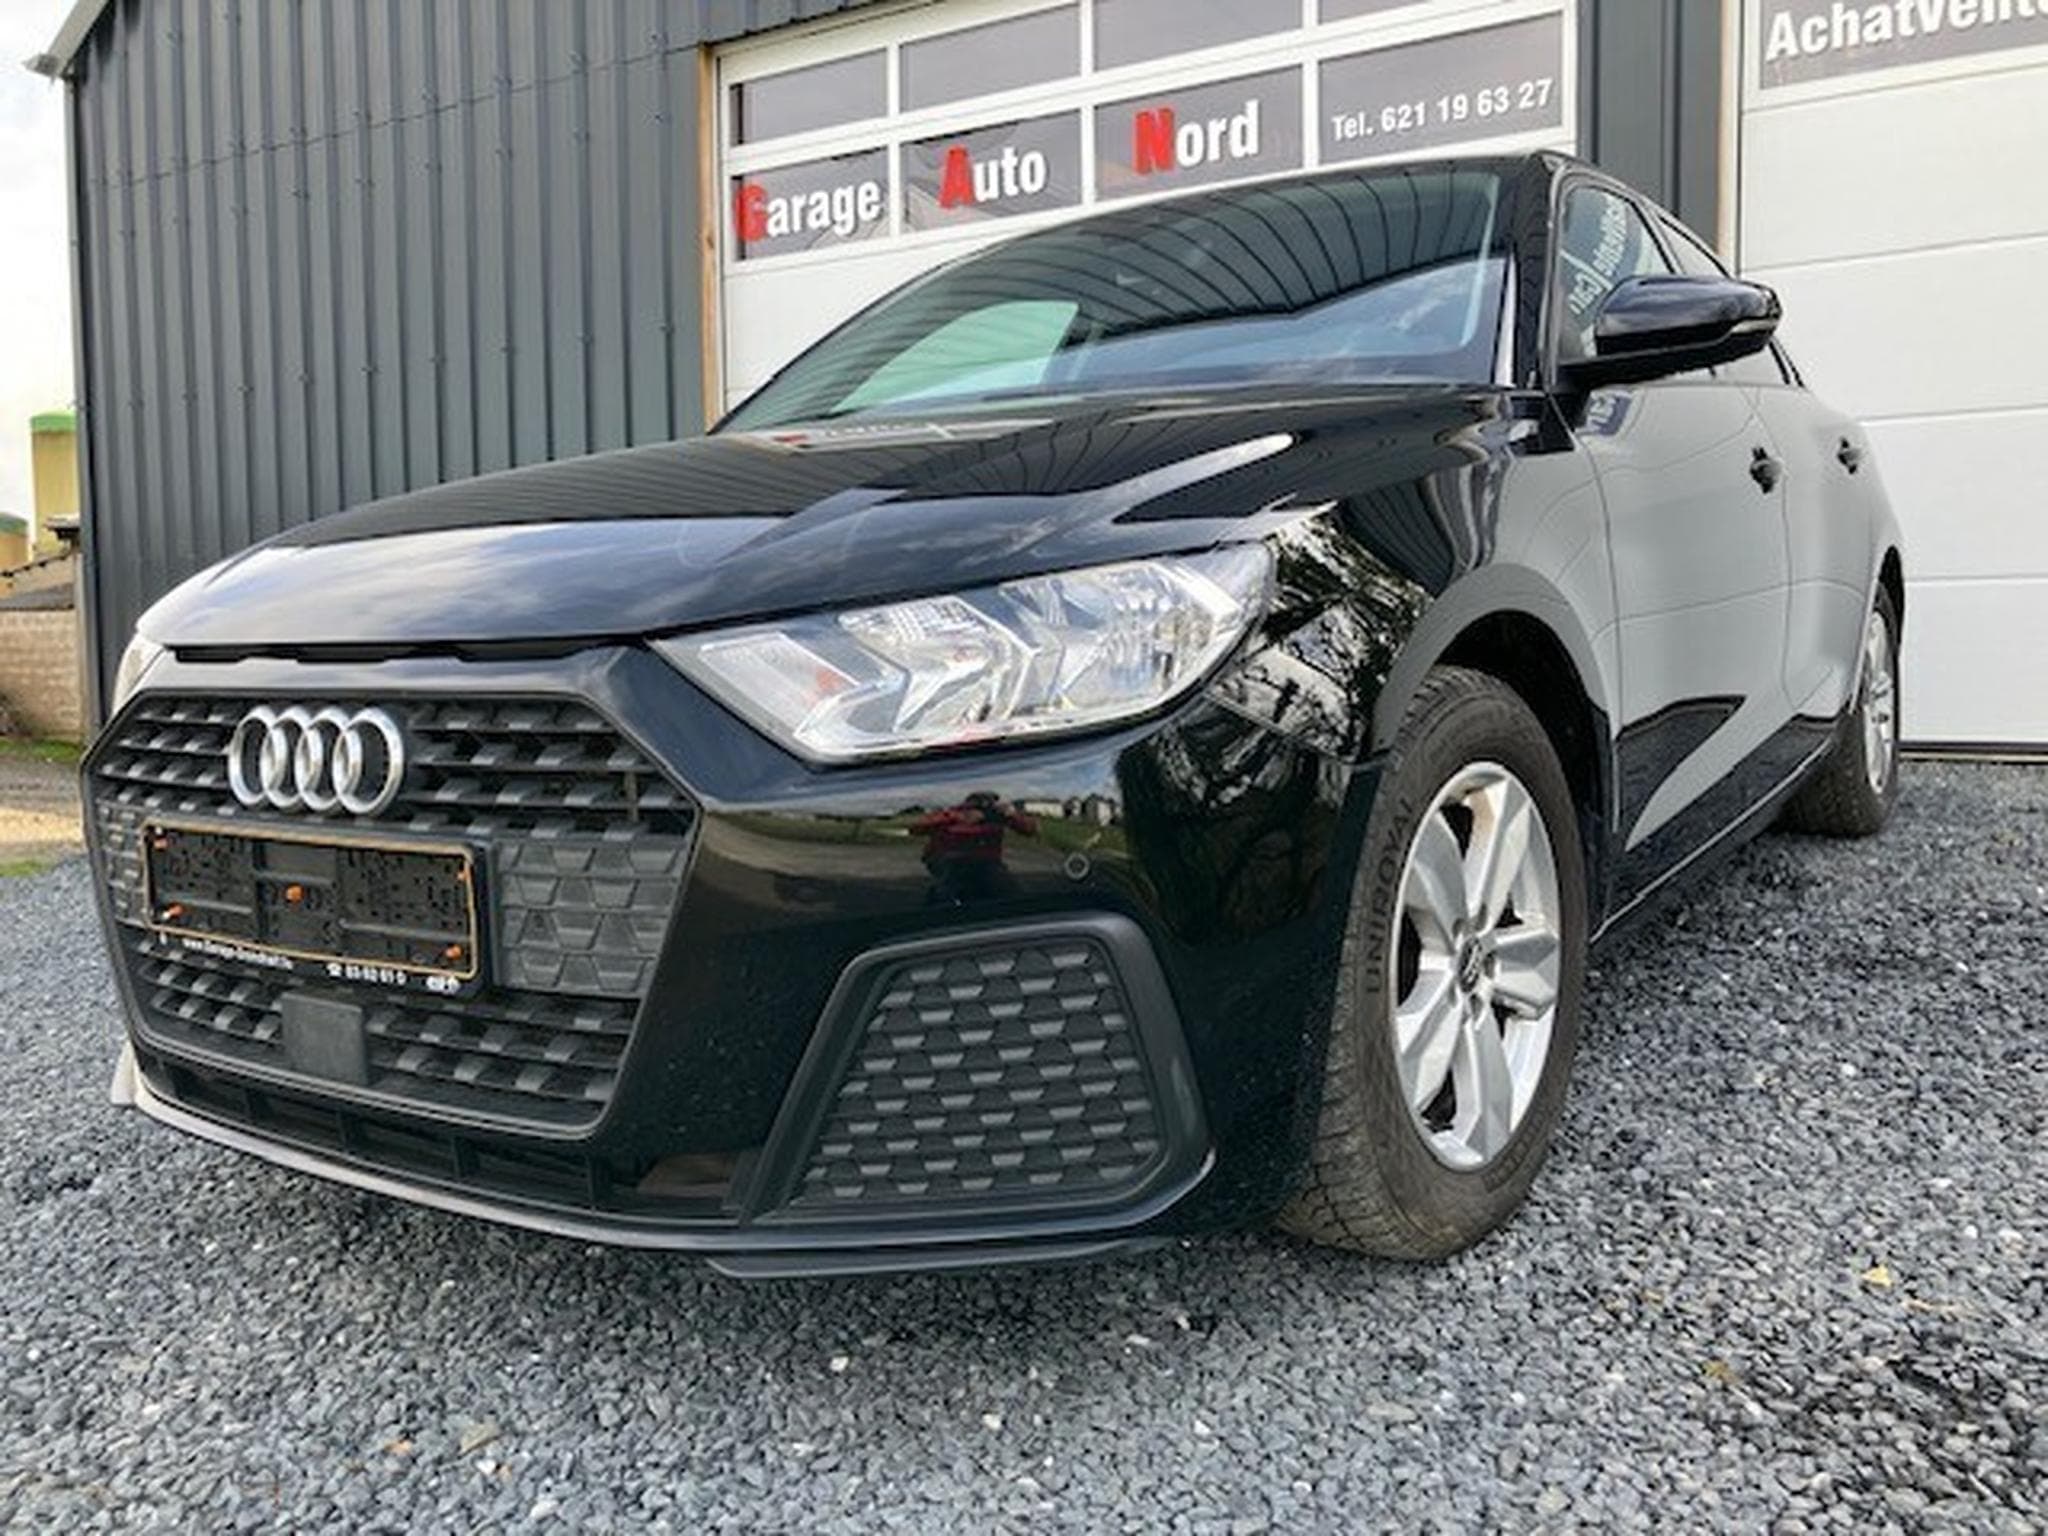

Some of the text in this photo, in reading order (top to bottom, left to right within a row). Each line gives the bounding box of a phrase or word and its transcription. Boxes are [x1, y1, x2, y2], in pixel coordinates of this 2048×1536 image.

[1765, 0, 2048, 61] AchatVen
[1331, 78, 1553, 141] Tel. 621 19 63 27
[734, 100, 1259, 242] Garage Auto Nord
